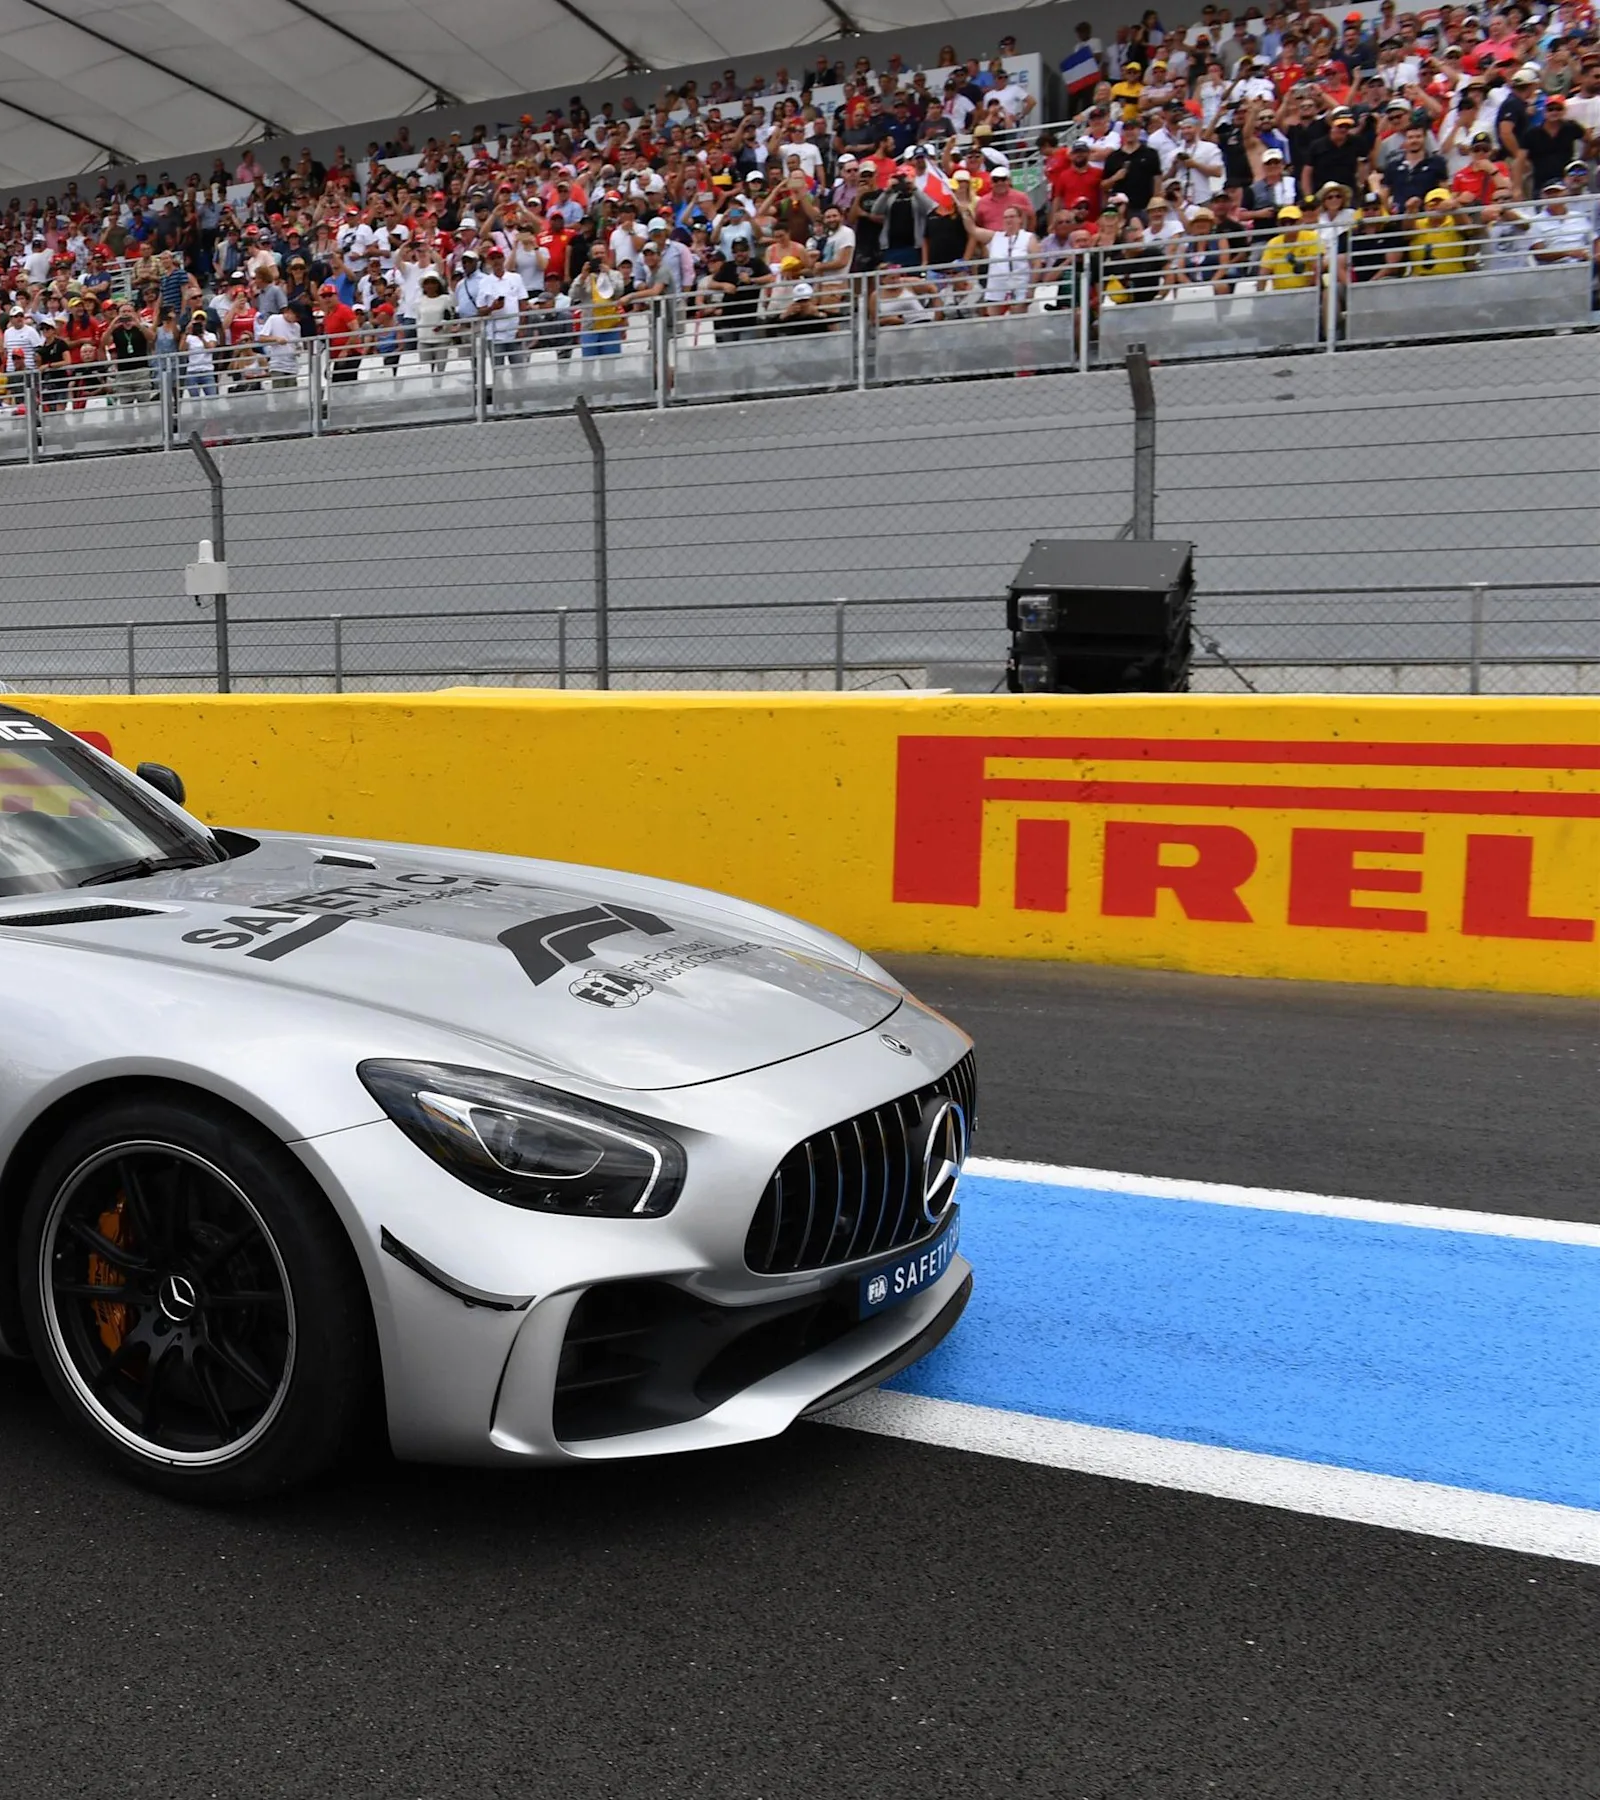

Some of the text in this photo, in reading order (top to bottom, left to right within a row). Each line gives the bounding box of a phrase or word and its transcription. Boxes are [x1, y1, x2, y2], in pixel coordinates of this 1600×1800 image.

[180, 880, 411, 950] SAFETY
[619, 959, 658, 976] FIA
[893, 1238, 949, 1294] SAFETY
